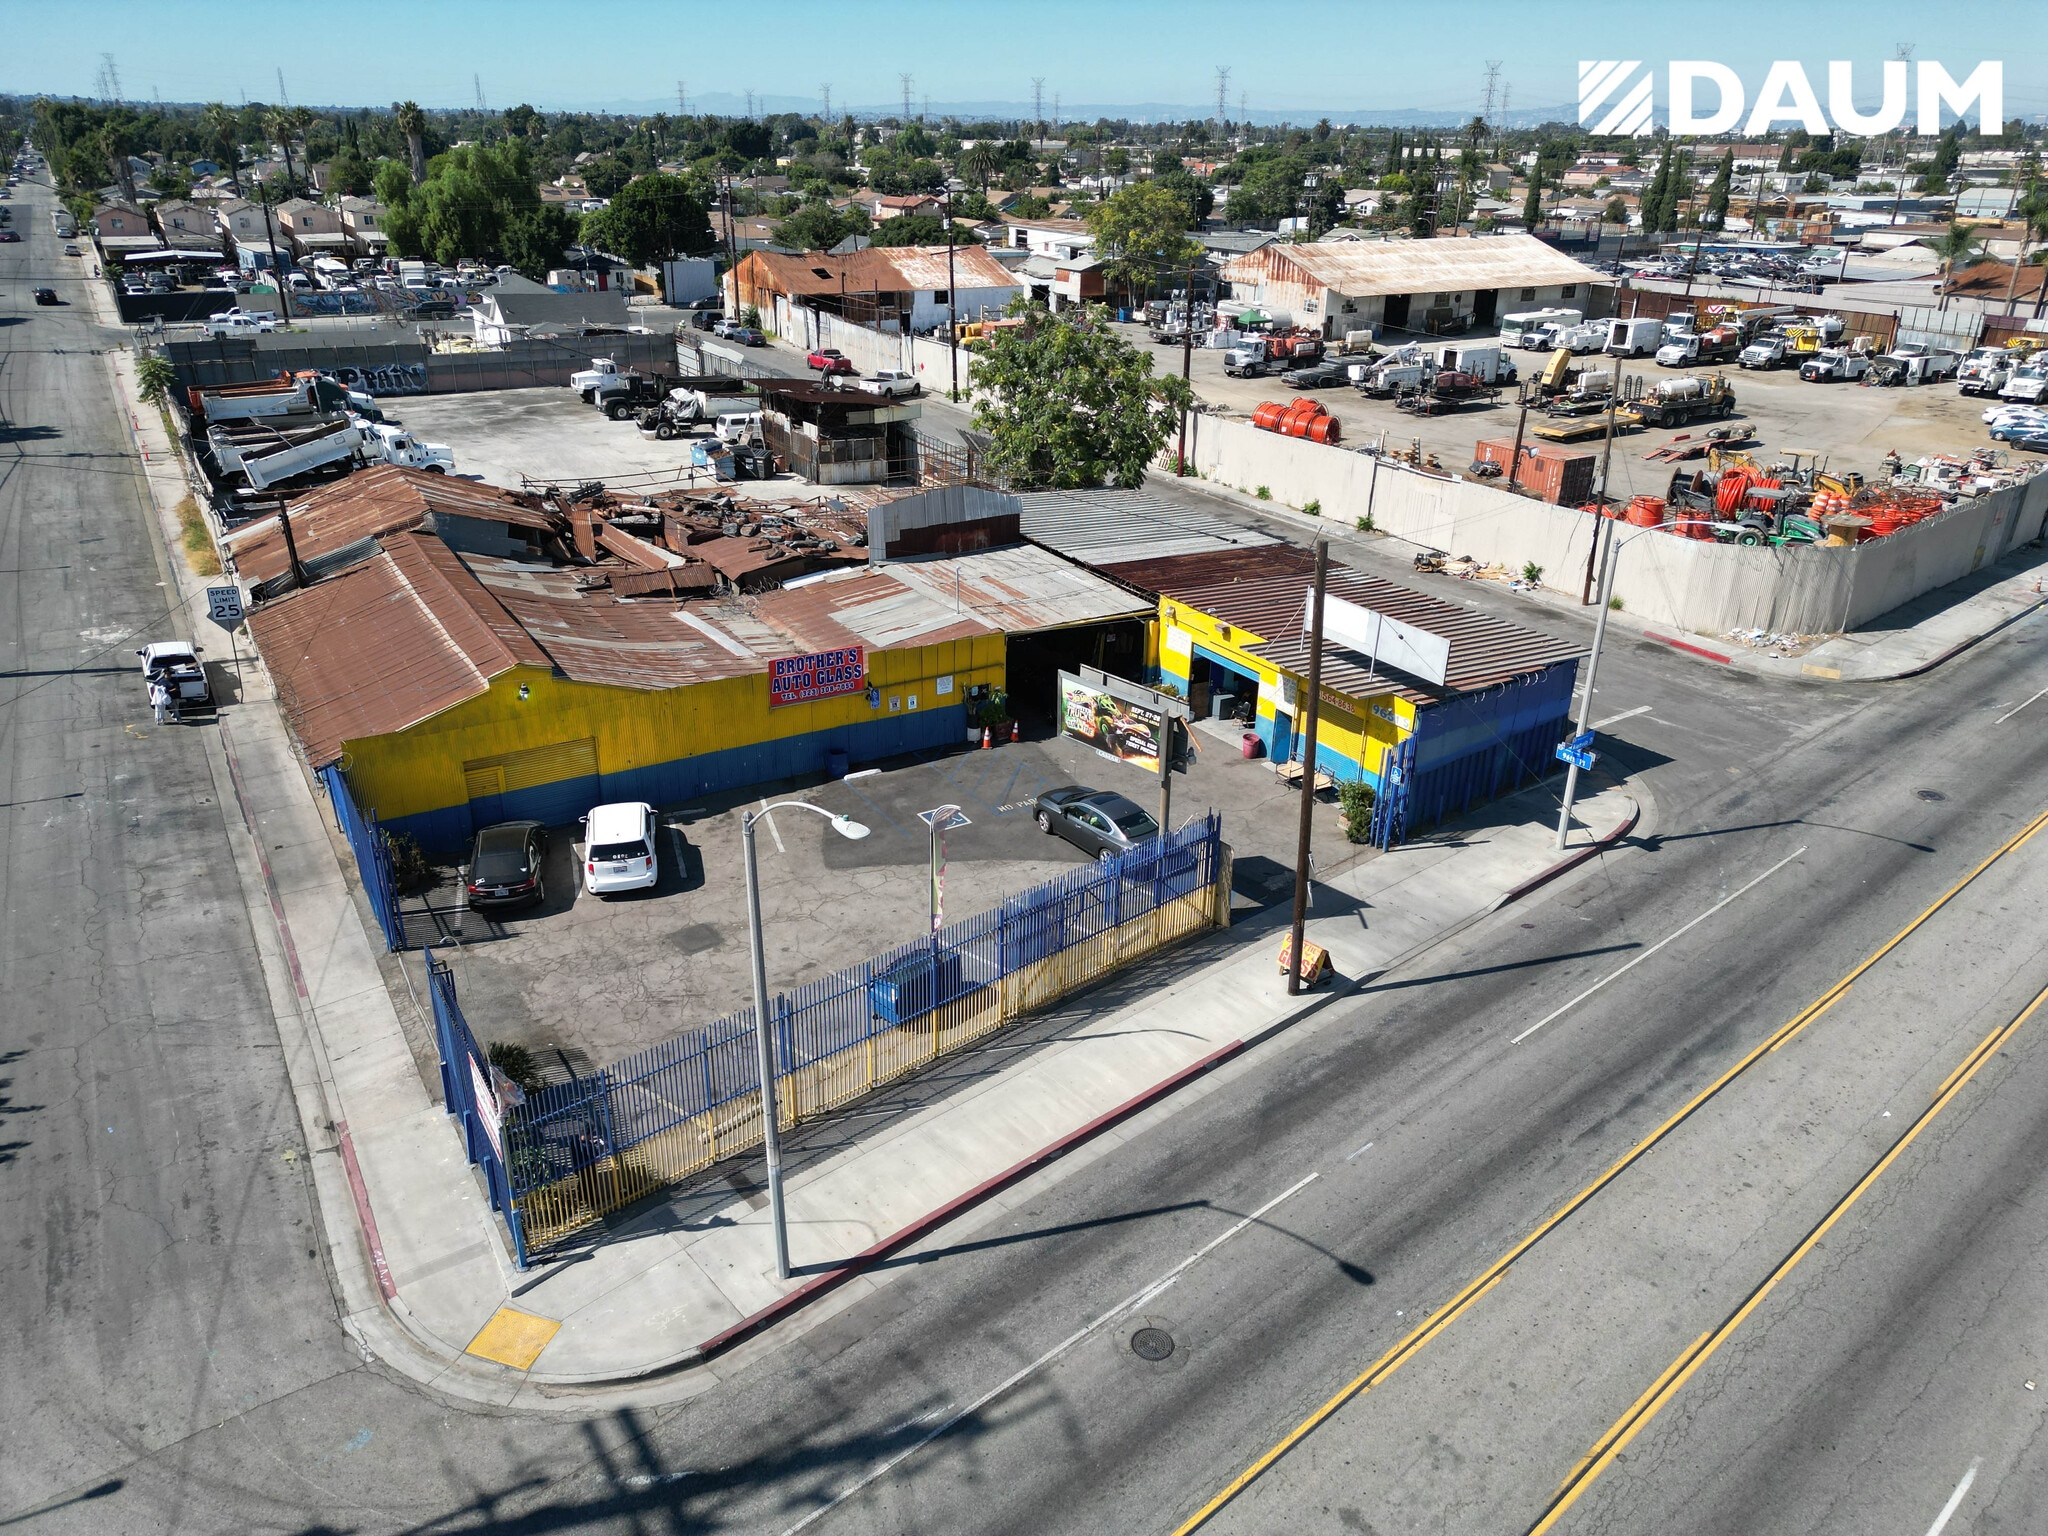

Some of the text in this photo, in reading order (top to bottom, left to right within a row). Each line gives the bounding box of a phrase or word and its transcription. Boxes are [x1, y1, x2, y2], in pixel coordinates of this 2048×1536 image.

[213, 596, 235, 604] LIMIT
[214, 604, 240, 618] 25
[776, 648, 857, 676] BROTHER'S
[772, 664, 862, 693] AUTO GLASS
[996, 804, 1014, 813] NO
